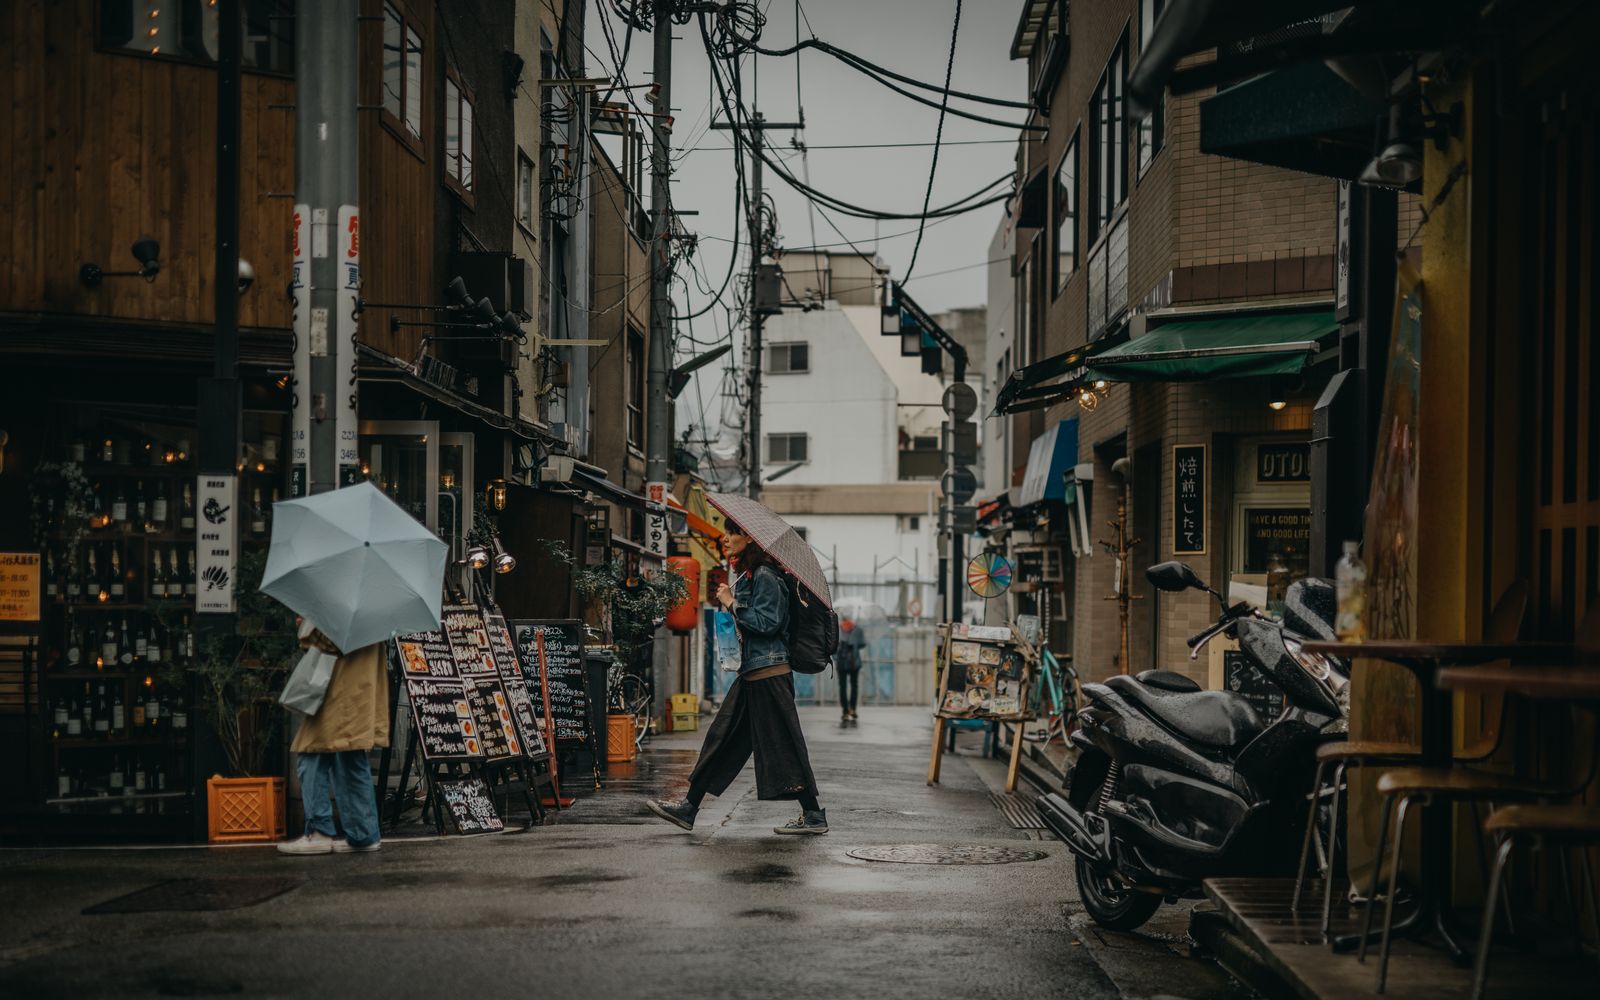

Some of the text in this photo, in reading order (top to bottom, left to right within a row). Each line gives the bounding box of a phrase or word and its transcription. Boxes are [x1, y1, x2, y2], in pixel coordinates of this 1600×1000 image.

[1178, 456, 1198, 544] 焙煎したて
[1272, 514, 1277, 525] A
[1278, 514, 1298, 525] GOOD
[1256, 528, 1310, 538] AND GOOD LIFE
